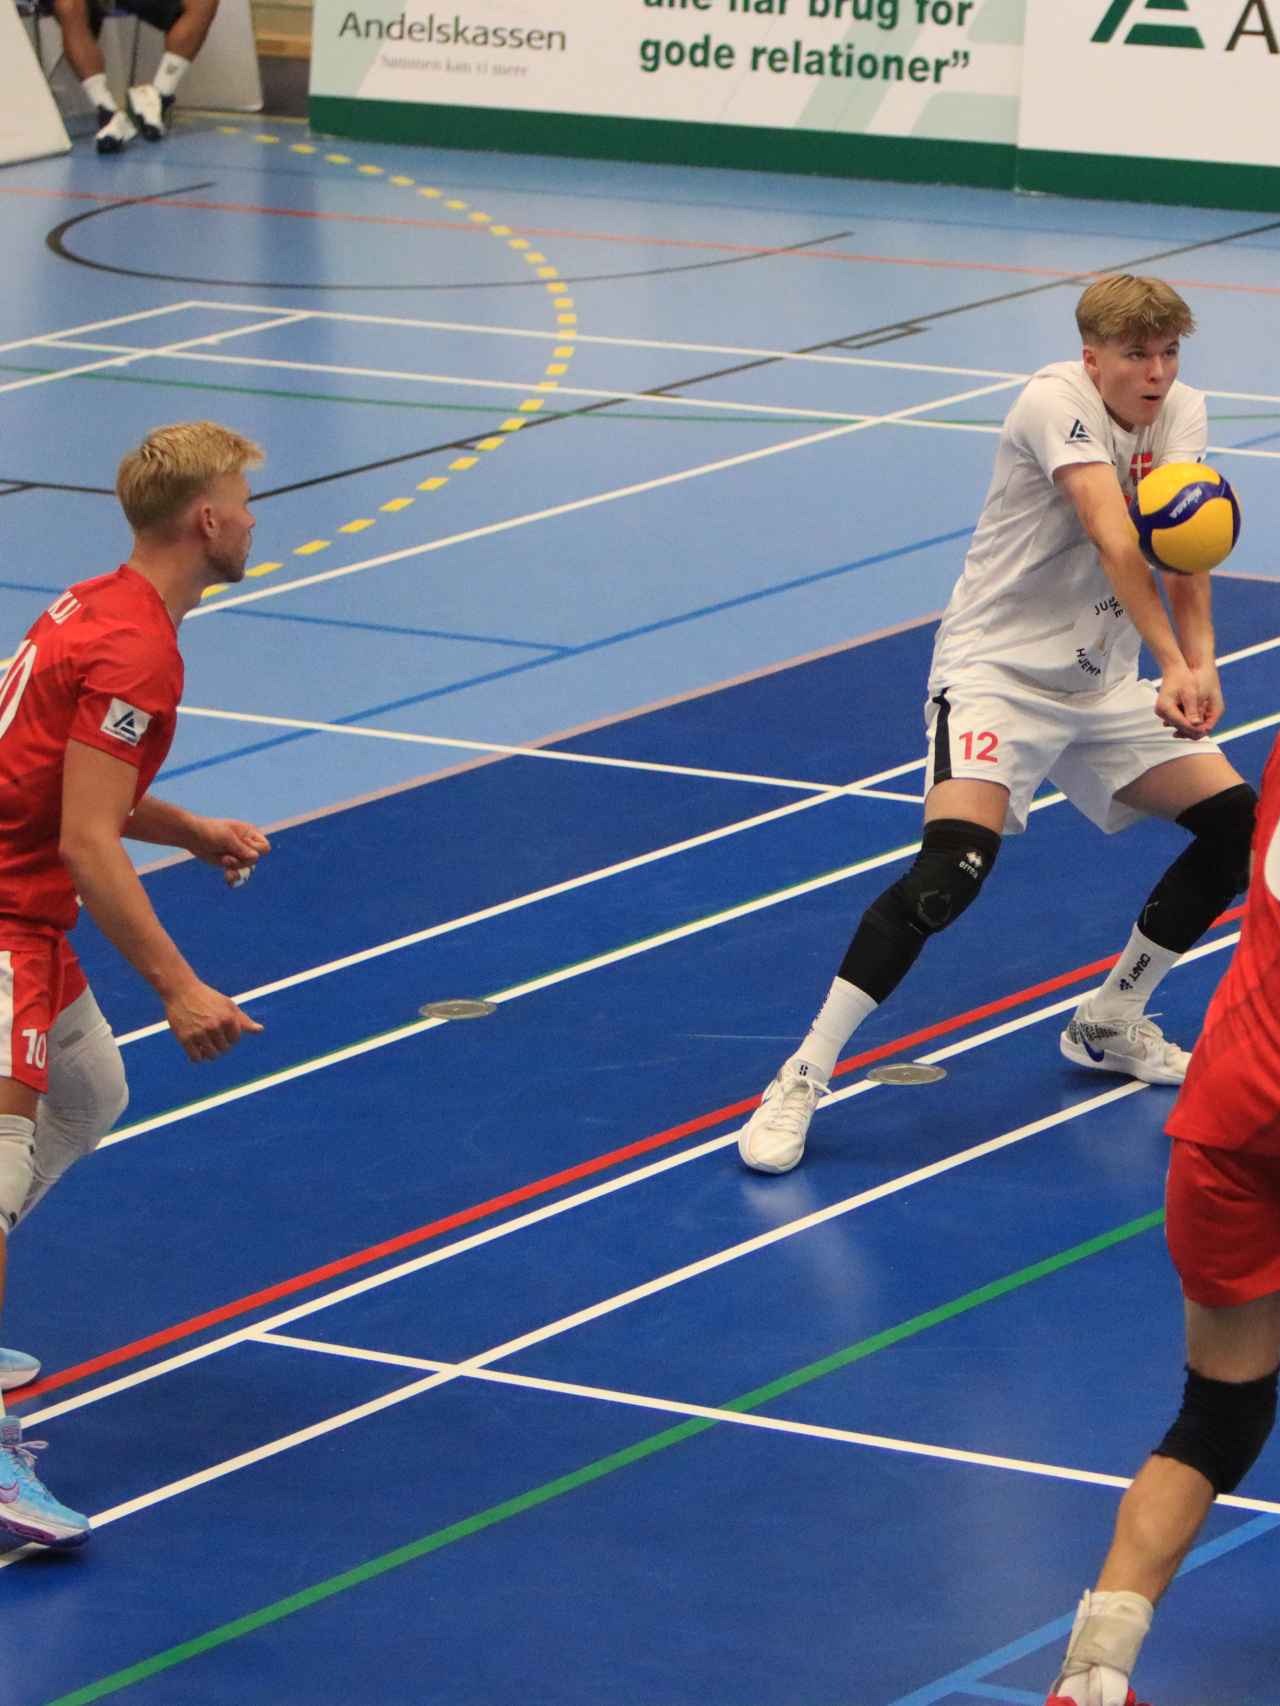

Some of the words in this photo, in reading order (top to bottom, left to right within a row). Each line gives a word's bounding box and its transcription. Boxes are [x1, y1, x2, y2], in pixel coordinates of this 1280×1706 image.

[338, 11, 567, 51] Andelskassen
[916, 0, 973, 27] for
[639, 34, 735, 73] gode
[959, 730, 999, 763] 12
[21, 1027, 47, 1070] 10
